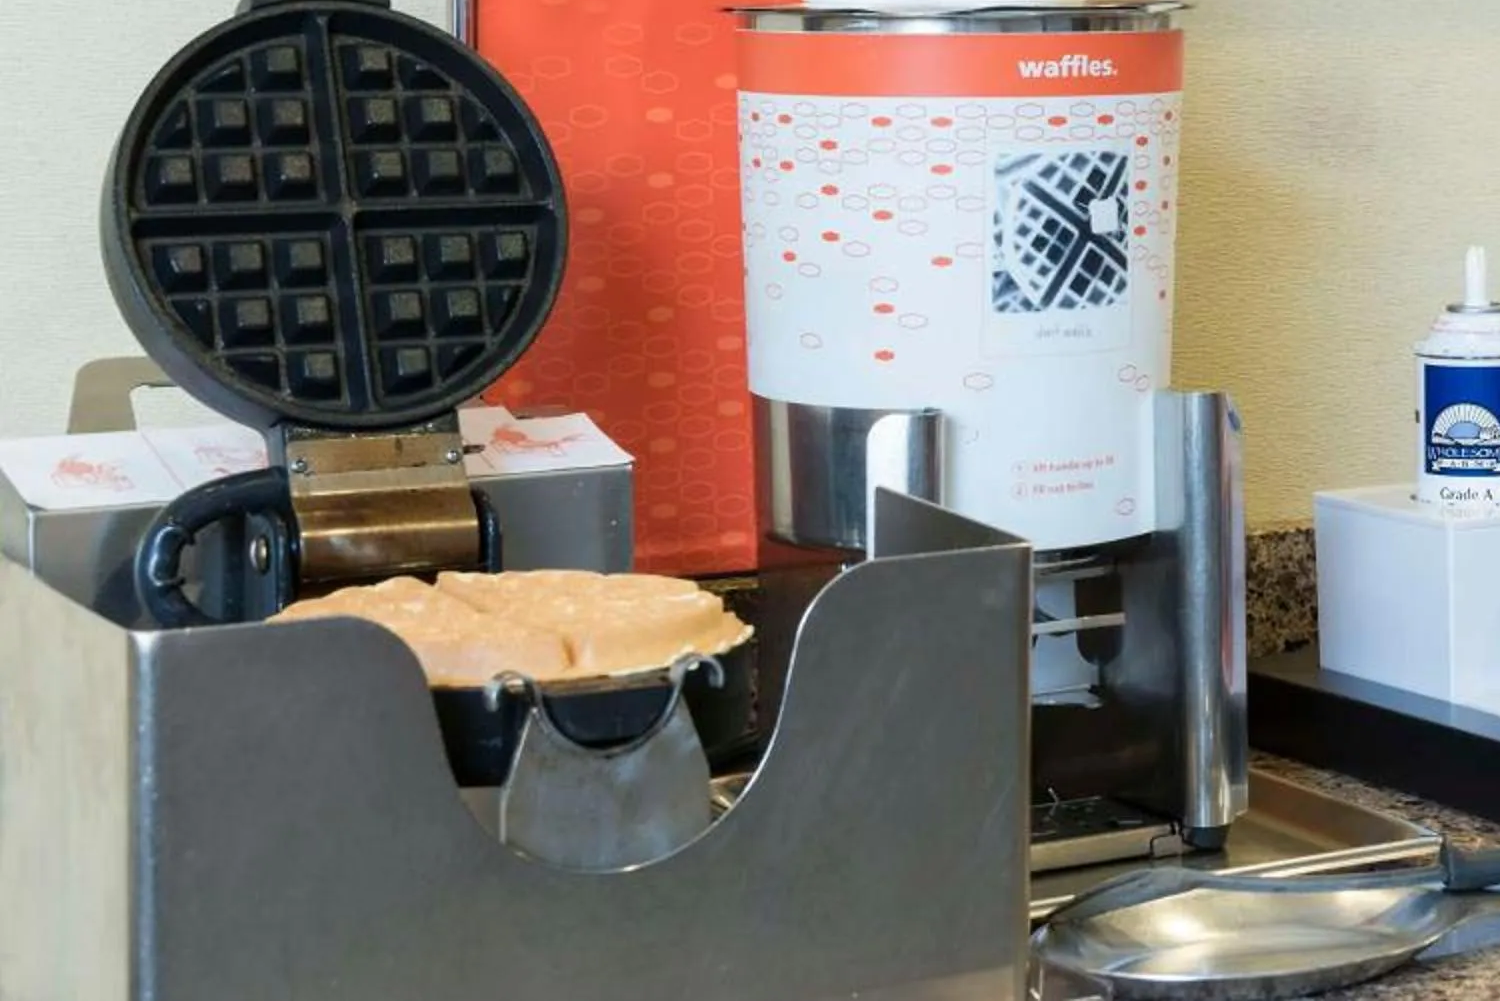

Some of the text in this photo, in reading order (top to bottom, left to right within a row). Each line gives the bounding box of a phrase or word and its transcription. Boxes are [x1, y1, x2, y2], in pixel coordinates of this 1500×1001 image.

[1018, 54, 1118, 78] waffles.
[1440, 486, 1494, 501] Grade A
